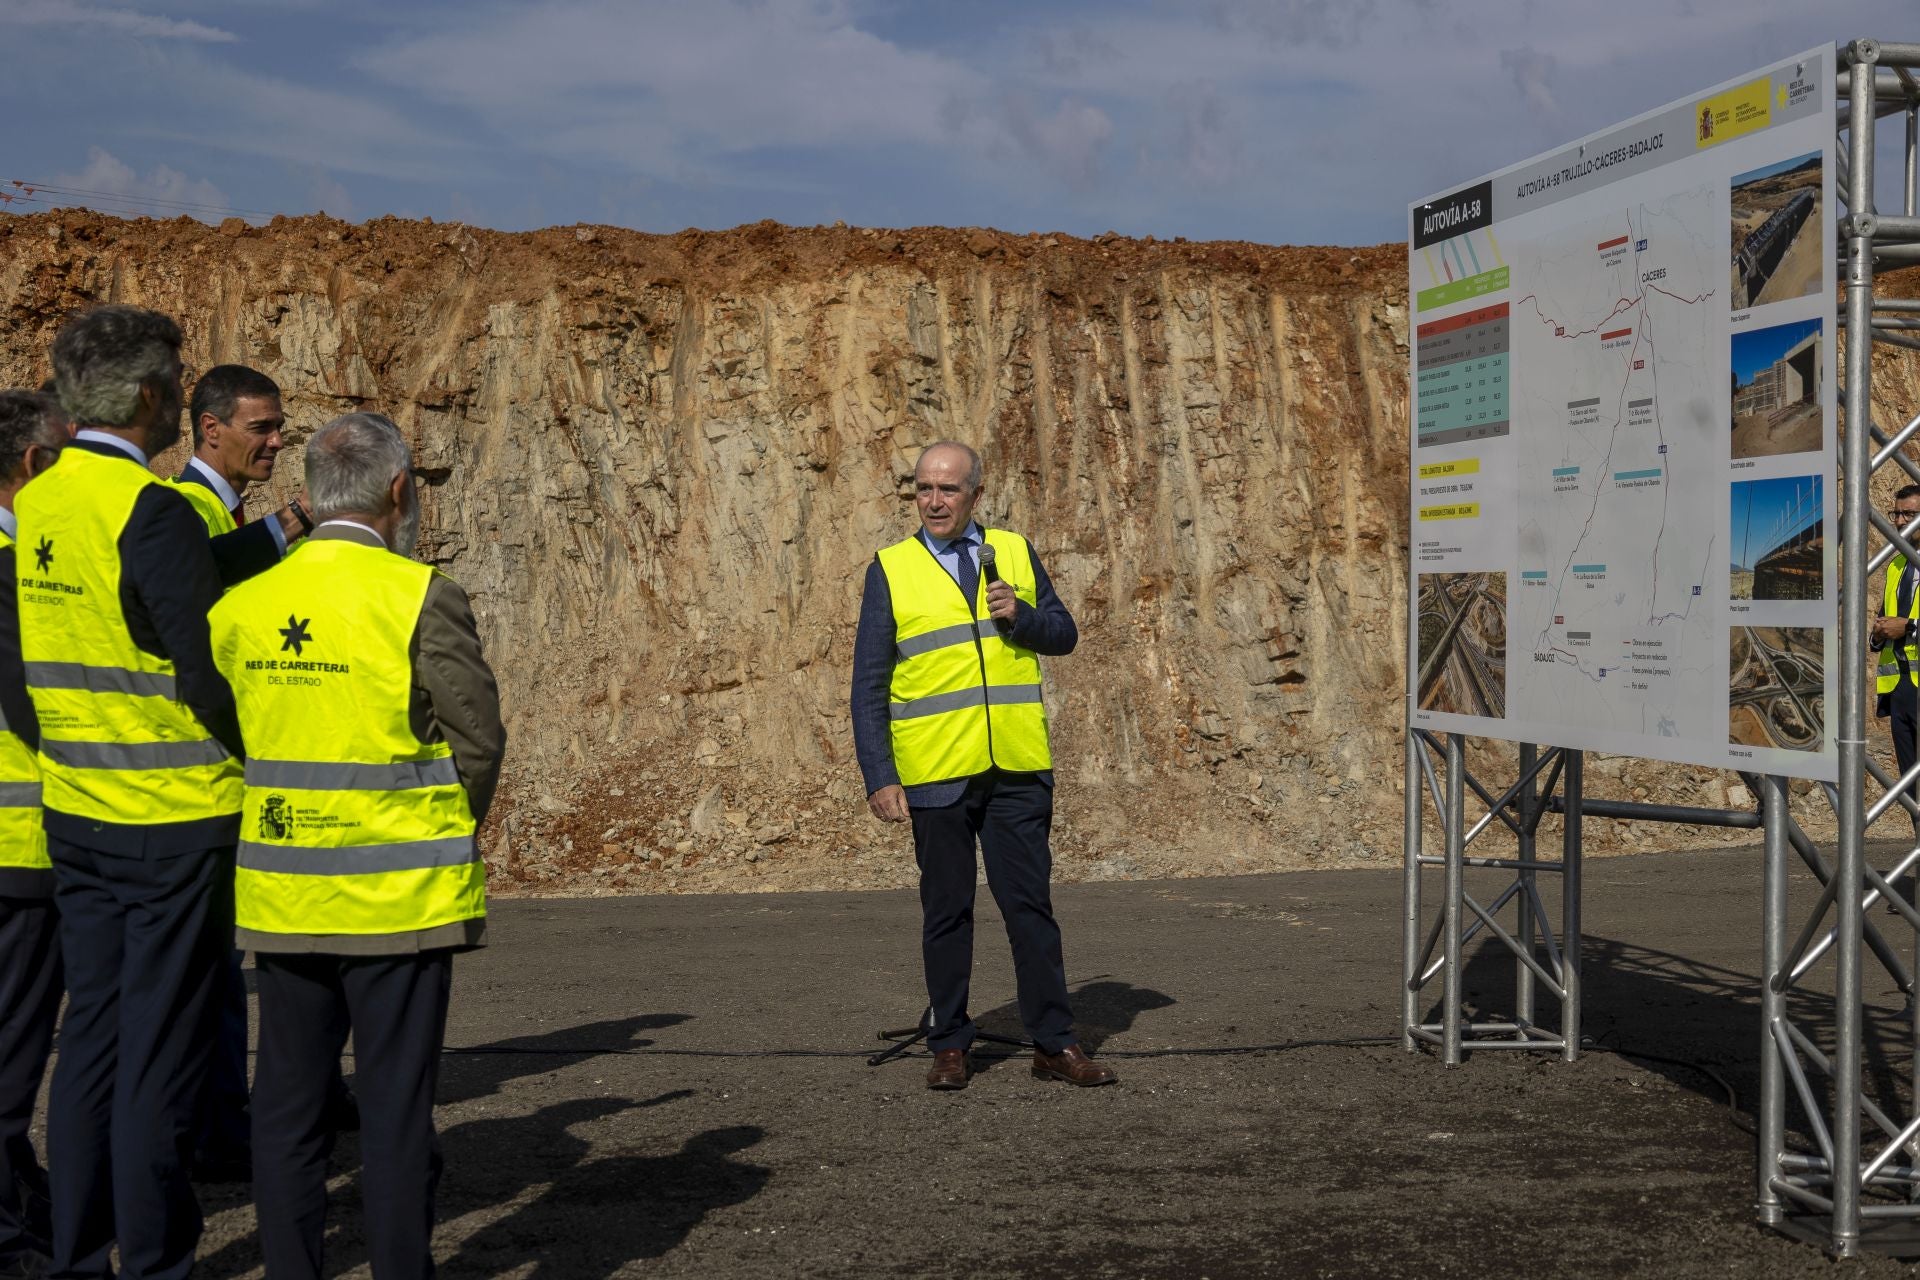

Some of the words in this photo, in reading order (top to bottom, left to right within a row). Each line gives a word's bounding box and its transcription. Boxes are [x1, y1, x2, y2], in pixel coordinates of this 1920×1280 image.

[1790, 83, 1815, 98] CARRETERAS
[1516, 176, 1545, 199] AUTOVÍA
[1546, 172, 1561, 188] A-58
[1561, 133, 1664, 184] TRUJILLO-CÁCERES-BADAJOZ
[1423, 203, 1460, 235] AUTOVÍA
[1462, 199, 1481, 221] A-58
[1642, 267, 1667, 283] CÁCERES
[21, 578, 34, 588] DE
[36, 580, 84, 595] CARRETRAS
[245, 660, 263, 670] RED
[265, 660, 278, 670] DE
[1534, 652, 1555, 663] BADAJOZ
[267, 676, 285, 685] DEL
[286, 676, 322, 687] ESTADO
